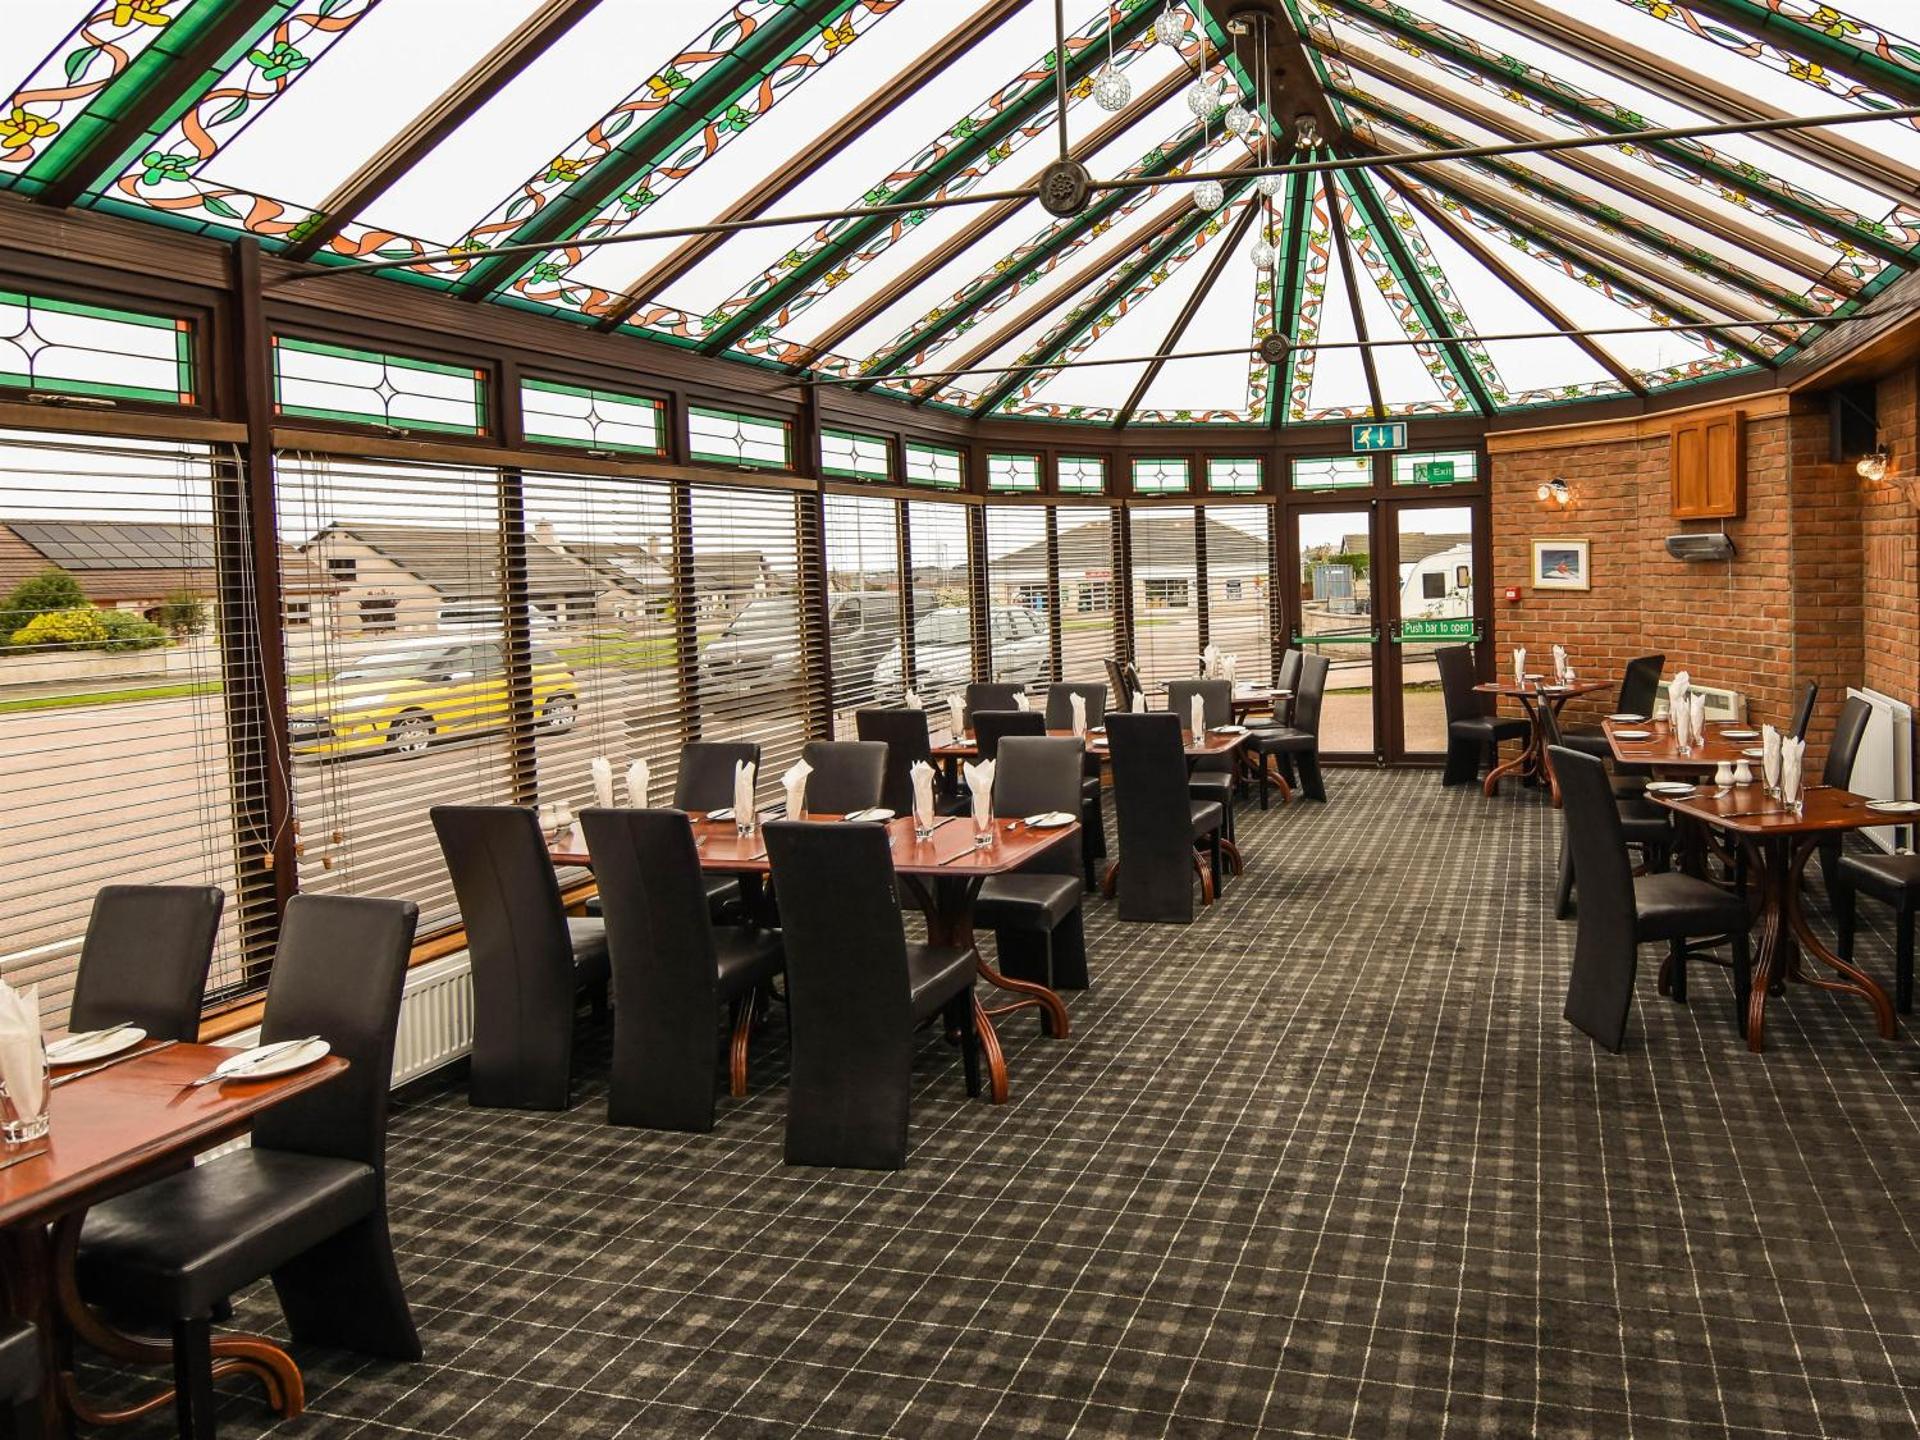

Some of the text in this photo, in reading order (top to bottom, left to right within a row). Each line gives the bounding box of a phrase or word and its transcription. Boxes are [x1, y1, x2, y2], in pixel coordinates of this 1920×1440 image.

[1433, 467, 1452, 476] Exit
[1405, 622, 1469, 634] Push bar to open
